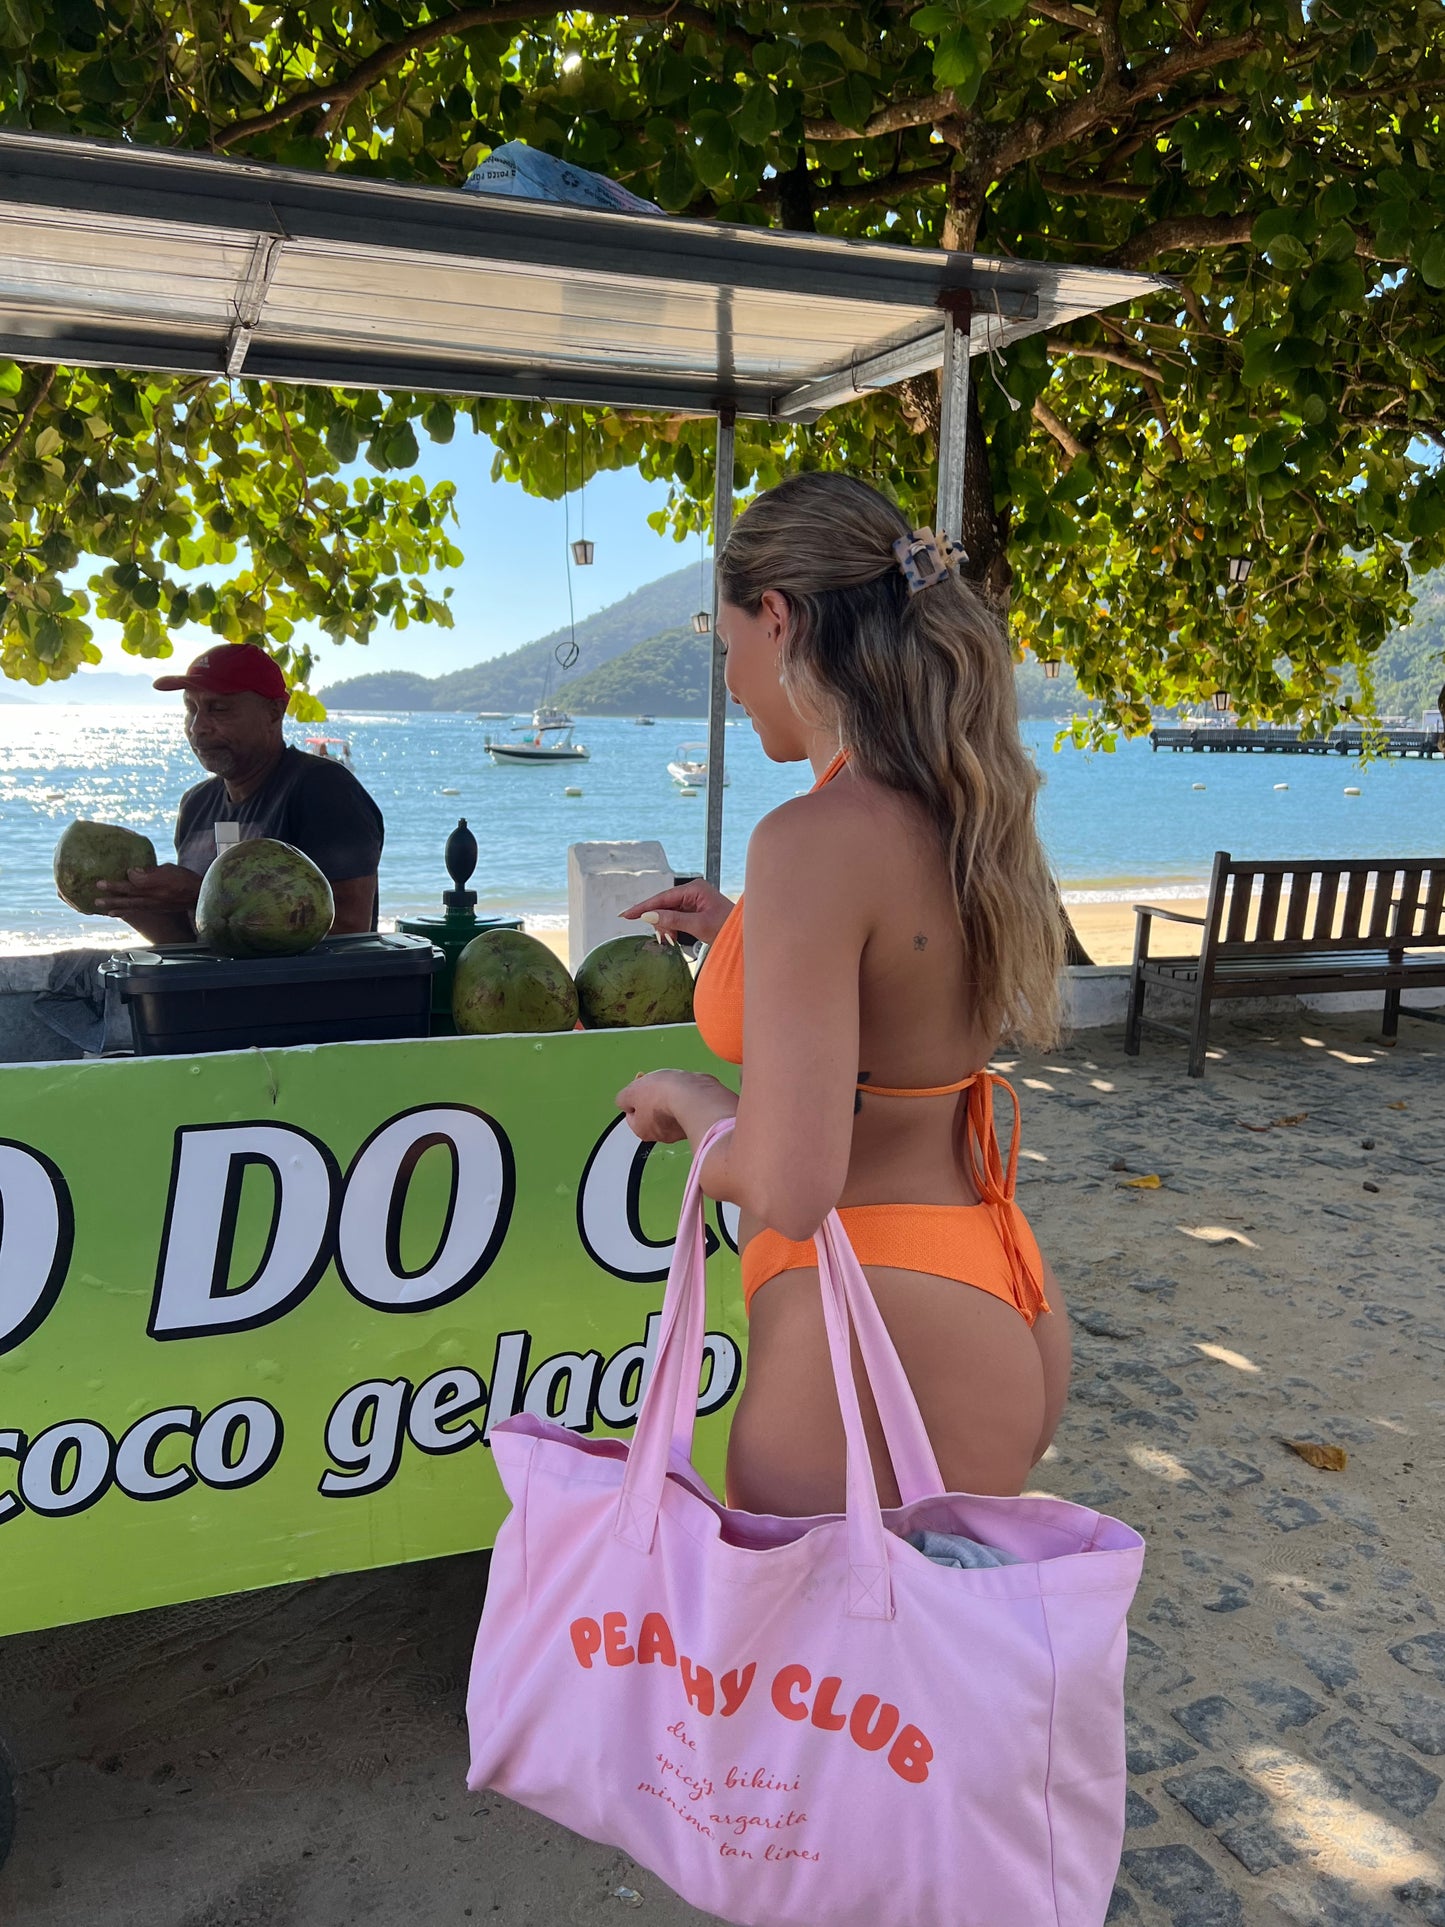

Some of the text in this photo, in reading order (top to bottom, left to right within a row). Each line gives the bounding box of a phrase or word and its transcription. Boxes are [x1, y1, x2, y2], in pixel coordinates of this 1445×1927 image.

[147, 1102, 516, 1341] DO
[576, 1111, 740, 1284] C
[318, 1313, 742, 1497] gelado
[569, 1611, 934, 1784] PEAHY CLUB
[709, 1810, 809, 1835] argarita
[724, 1766, 801, 1792] bikini
[719, 1843, 753, 1860] tan
[764, 1844, 821, 1863] lines
